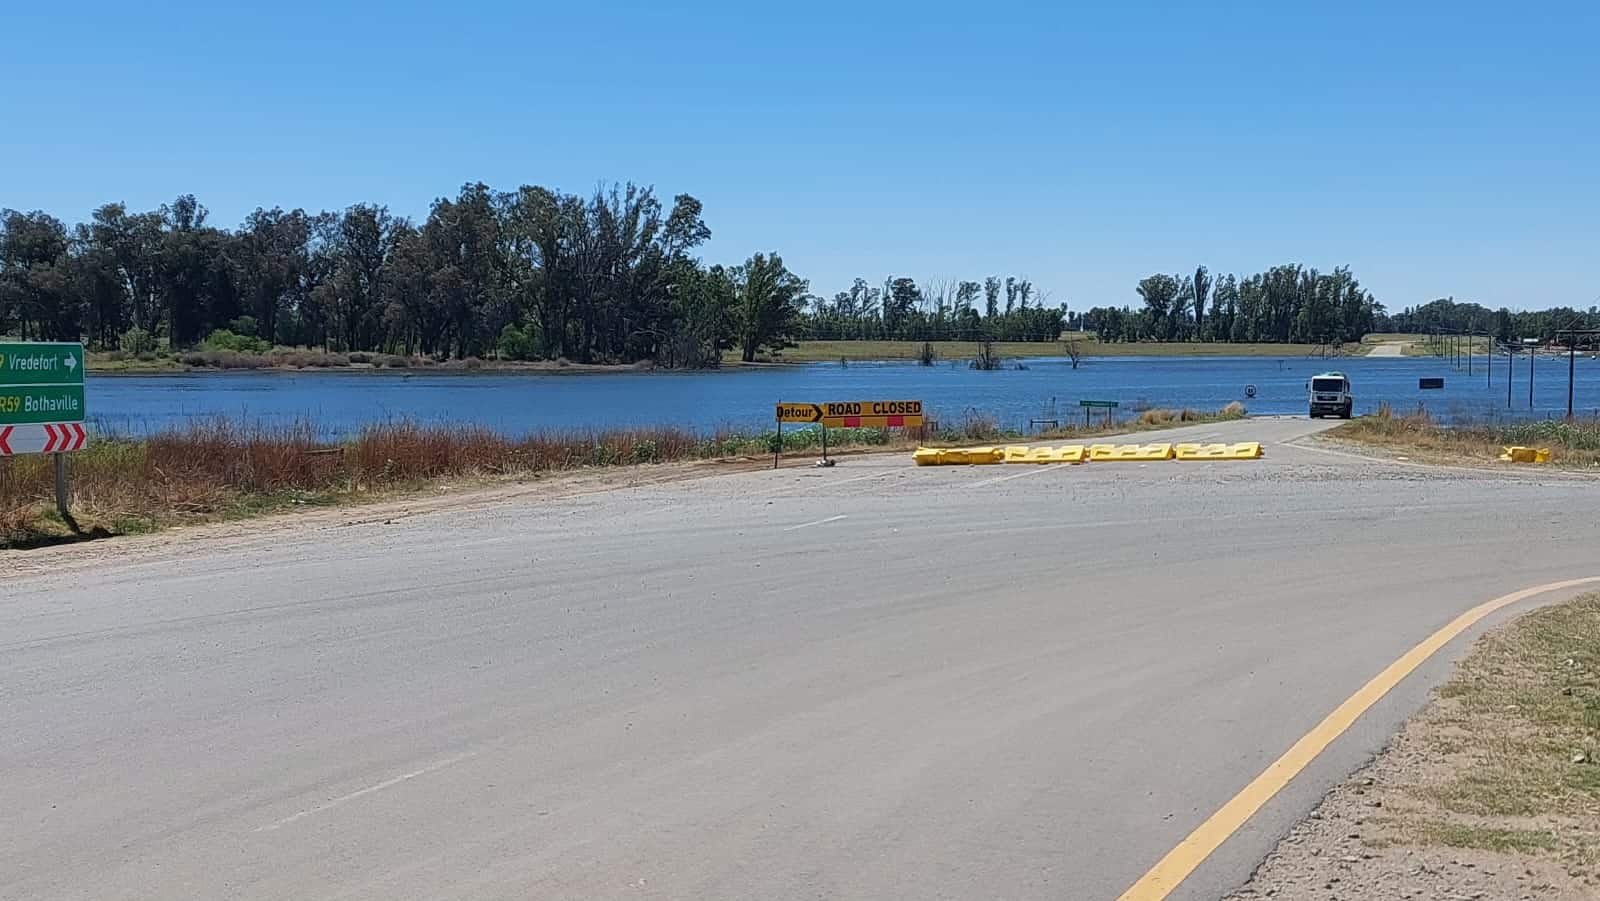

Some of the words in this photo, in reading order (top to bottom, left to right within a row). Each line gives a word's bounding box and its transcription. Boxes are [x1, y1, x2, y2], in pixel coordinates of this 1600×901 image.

[9, 353, 57, 370] Vredefort
[0, 396, 20, 412] R59
[25, 394, 78, 412] Bothaville
[828, 403, 861, 415] ROAD
[873, 401, 921, 414] CLOSED
[777, 406, 812, 418] Detour
